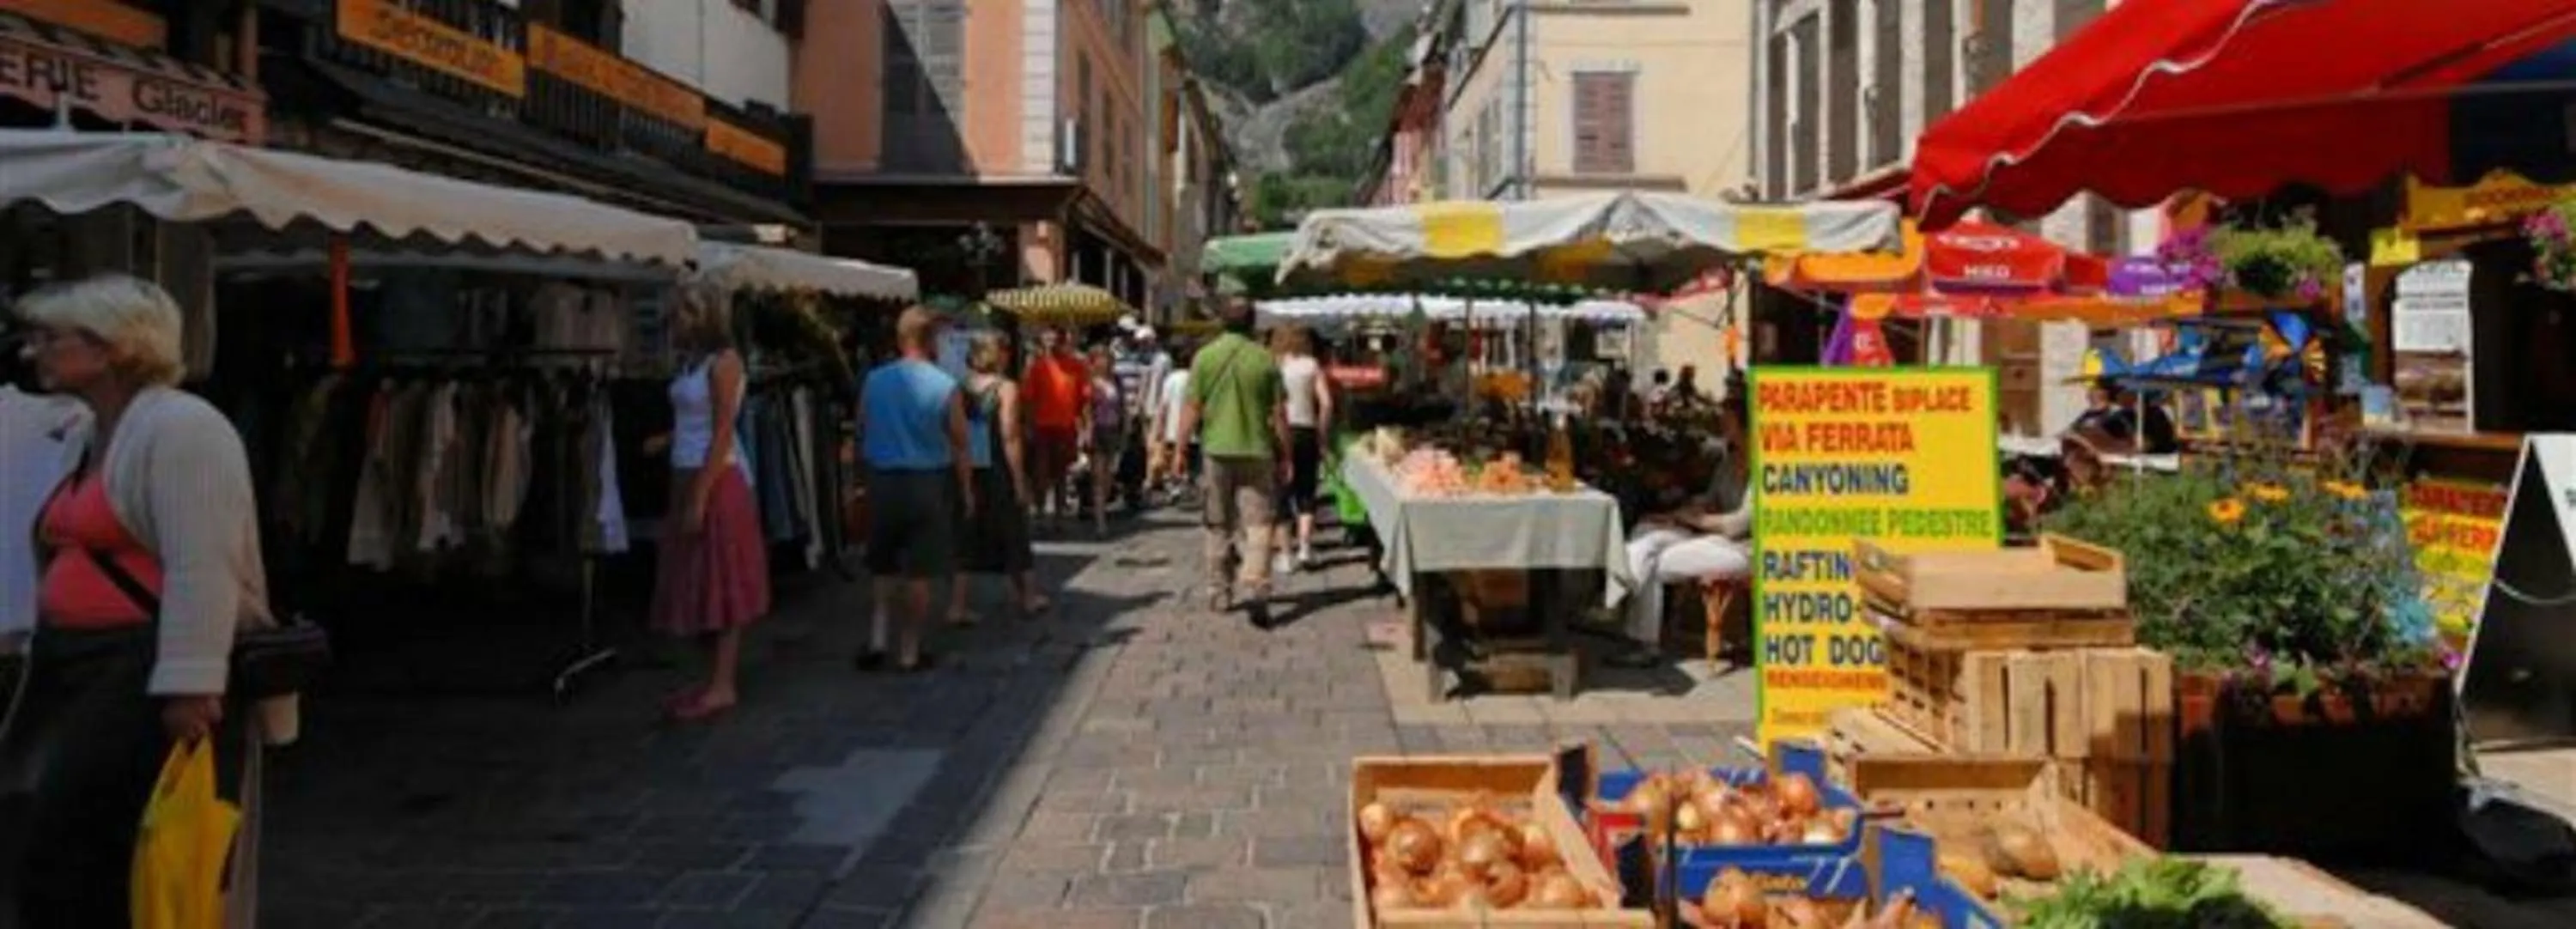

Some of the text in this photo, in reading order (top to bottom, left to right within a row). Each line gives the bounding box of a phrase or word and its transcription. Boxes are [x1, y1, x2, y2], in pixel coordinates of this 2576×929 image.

[1758, 381, 1886, 411] PARAPENTE
[1759, 422, 1914, 452] VIA FERRATA
[1762, 463, 1910, 495] CANYONING
[1888, 509, 1992, 537] PEDESTRE
[1766, 635, 1885, 664] HOT DOG
